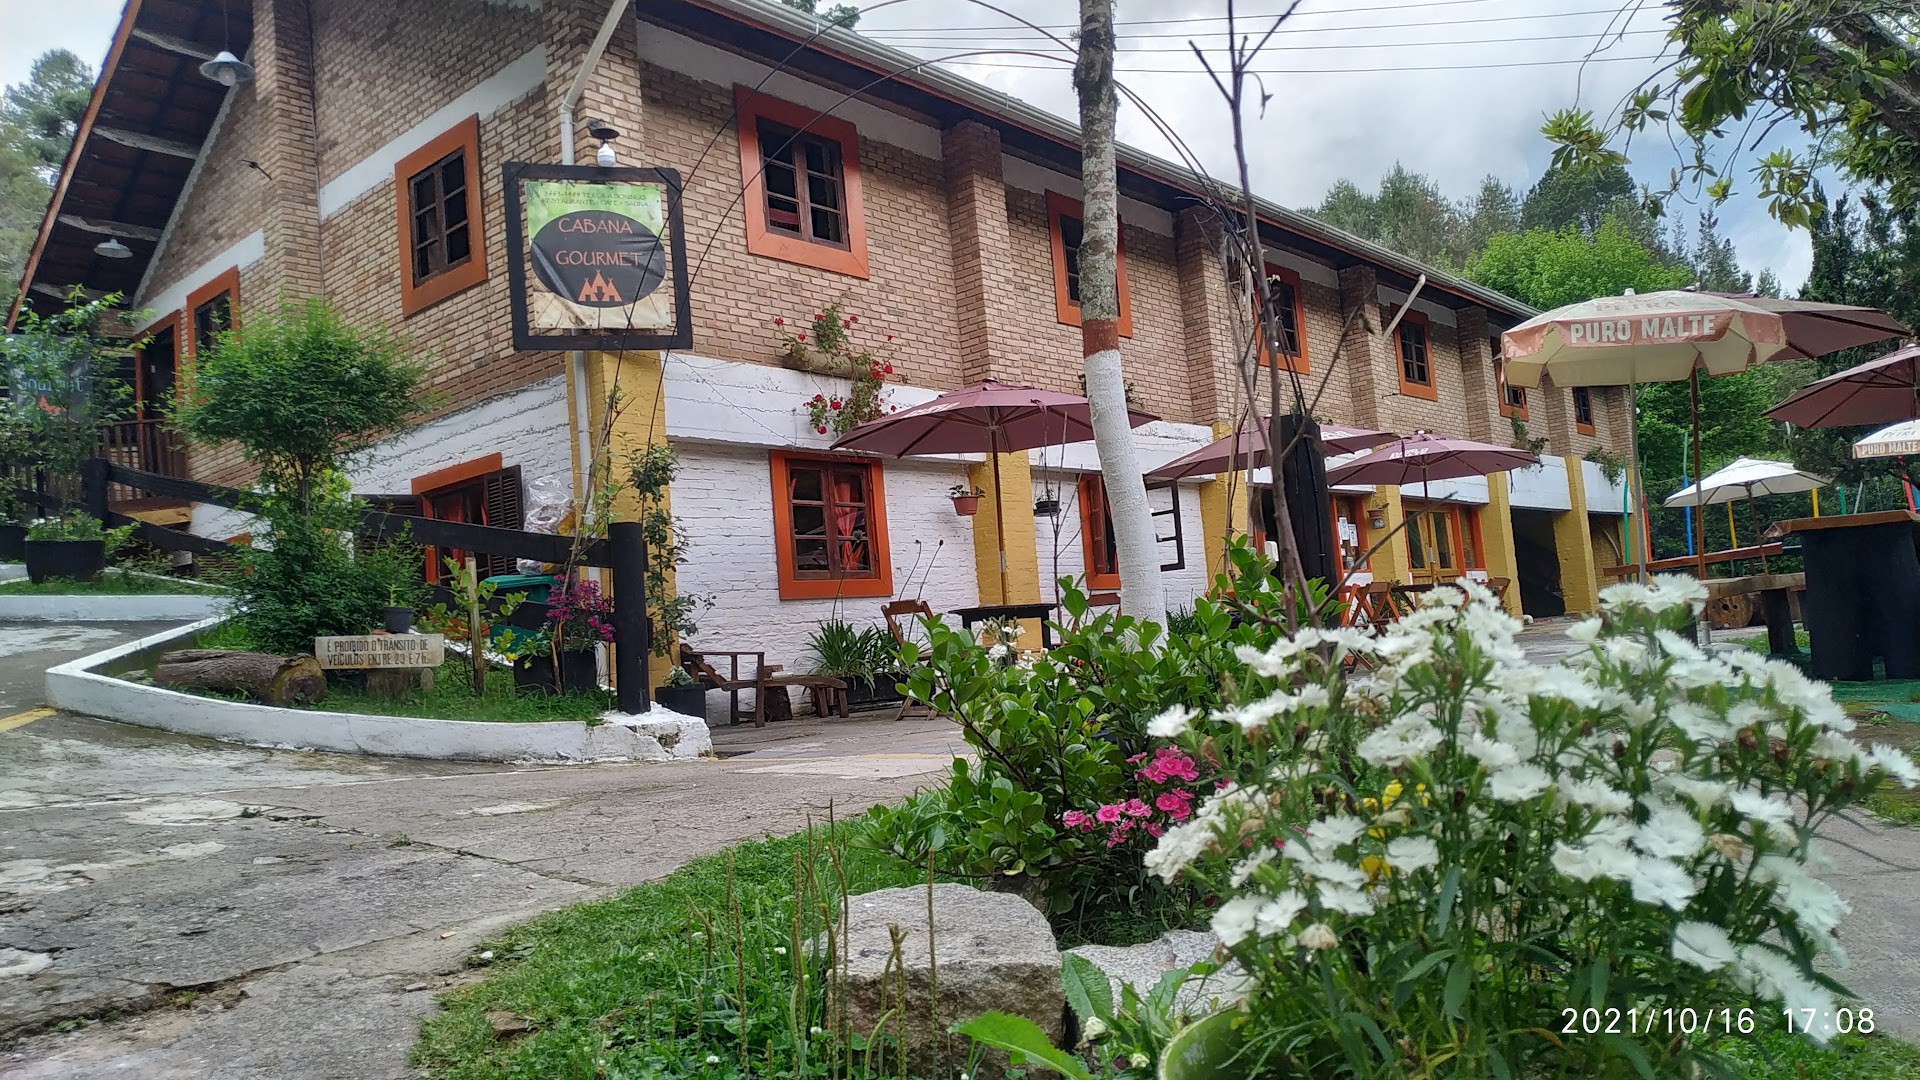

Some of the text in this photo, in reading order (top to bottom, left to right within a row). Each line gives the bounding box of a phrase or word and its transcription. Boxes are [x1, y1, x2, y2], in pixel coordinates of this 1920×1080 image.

[558, 218, 633, 234] CABANA
[555, 249, 643, 267] GOURMET
[1570, 314, 1716, 344] PURO MALTE
[1861, 441, 1918, 455] PURO MALTE
[334, 639, 369, 652] PROIBIDO
[372, 640, 377, 652] O
[419, 639, 429, 651] DE
[367, 653, 391, 665] ENTRE
[394, 653, 406, 665] 23
[409, 653, 413, 664] E
